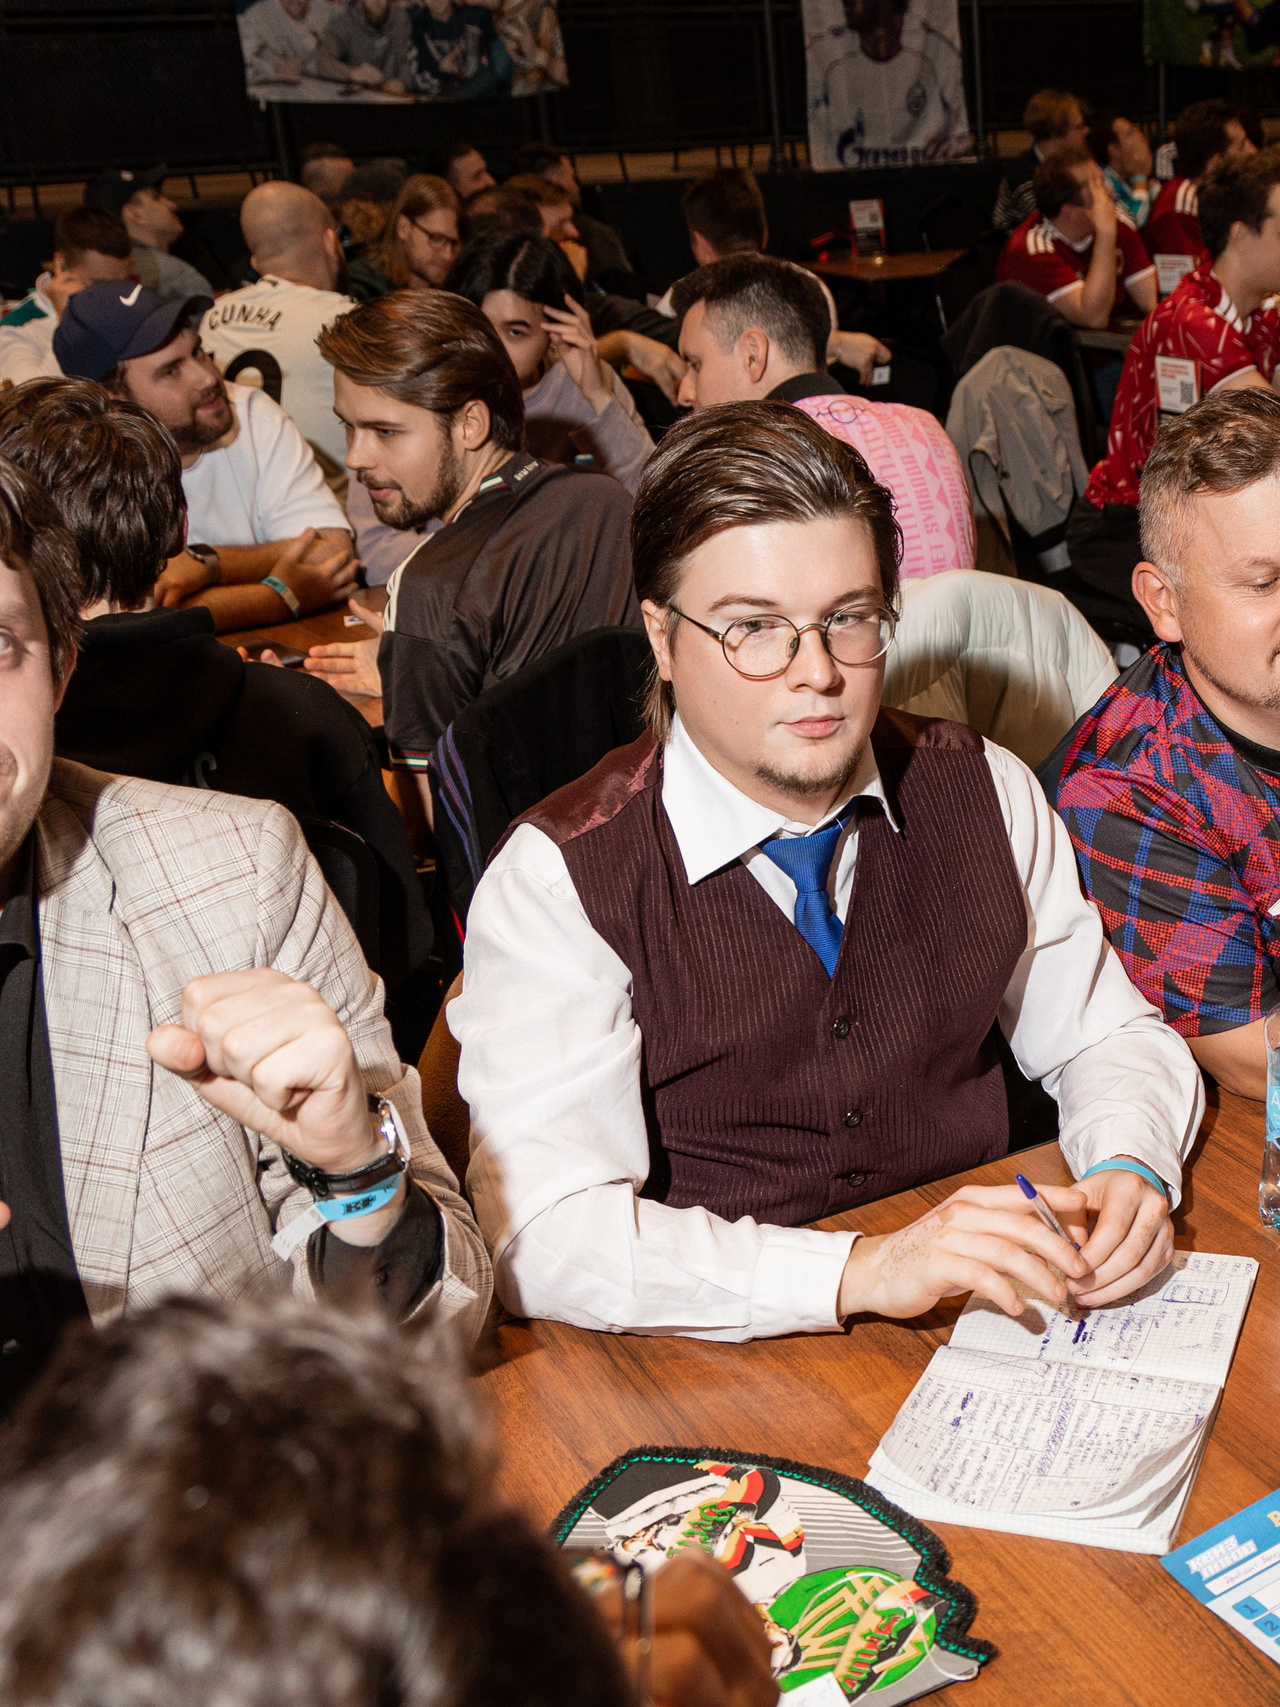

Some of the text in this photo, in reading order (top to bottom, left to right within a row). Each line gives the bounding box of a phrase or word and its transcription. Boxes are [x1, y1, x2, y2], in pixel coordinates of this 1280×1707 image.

[208, 303, 282, 332] CUNHA
[1185, 1534, 1239, 1575] КВИЗ
[1201, 1538, 1258, 1582] ПЛЮС
[1245, 1604, 1258, 1614] 1
[1264, 1620, 1279, 1632] 2
